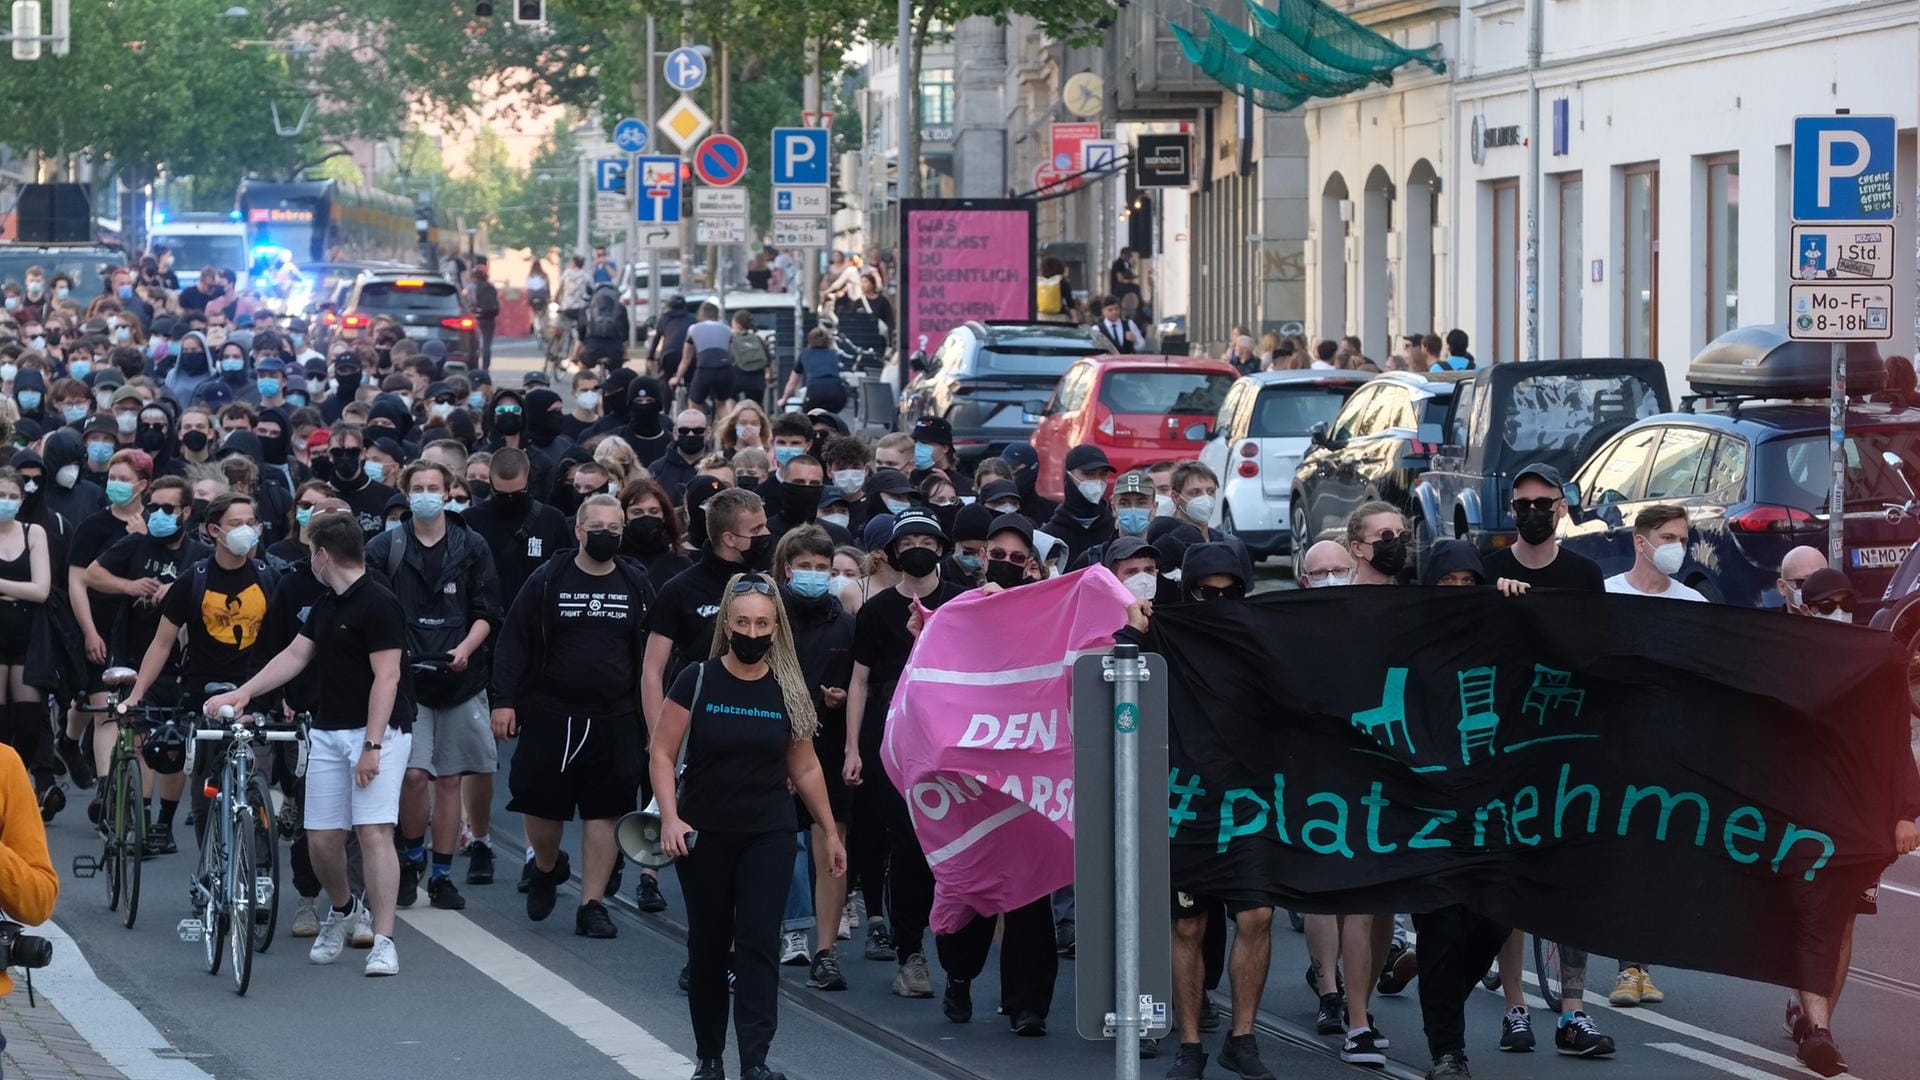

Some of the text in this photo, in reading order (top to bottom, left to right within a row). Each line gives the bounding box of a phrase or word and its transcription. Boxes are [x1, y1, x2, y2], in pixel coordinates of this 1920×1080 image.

[785, 136, 816, 178] P
[1818, 130, 1871, 207] P
[1858, 172, 1890, 185] CHEMIE
[1859, 182, 1891, 194] LEIPZIG
[1860, 191, 1892, 204] GEBIET
[917, 218, 957, 232] WAS
[918, 235, 989, 249] MACHST
[1838, 245, 1881, 260] 1 Std.
[918, 269, 1018, 282] EIGENTLICH
[918, 286, 945, 298] AM
[1812, 293, 1870, 309] Mo-Fr
[918, 303, 1000, 315] WOCHEN-
[1817, 315, 1867, 330] 8-18h
[1861, 550, 1871, 563] N
[1878, 548, 1897, 562] MO
[586, 610, 627, 619] CAPITALISM
[705, 703, 782, 720] #platznehmen
[956, 708, 1057, 752] DEN
[1169, 763, 1835, 881] #platznehmen
